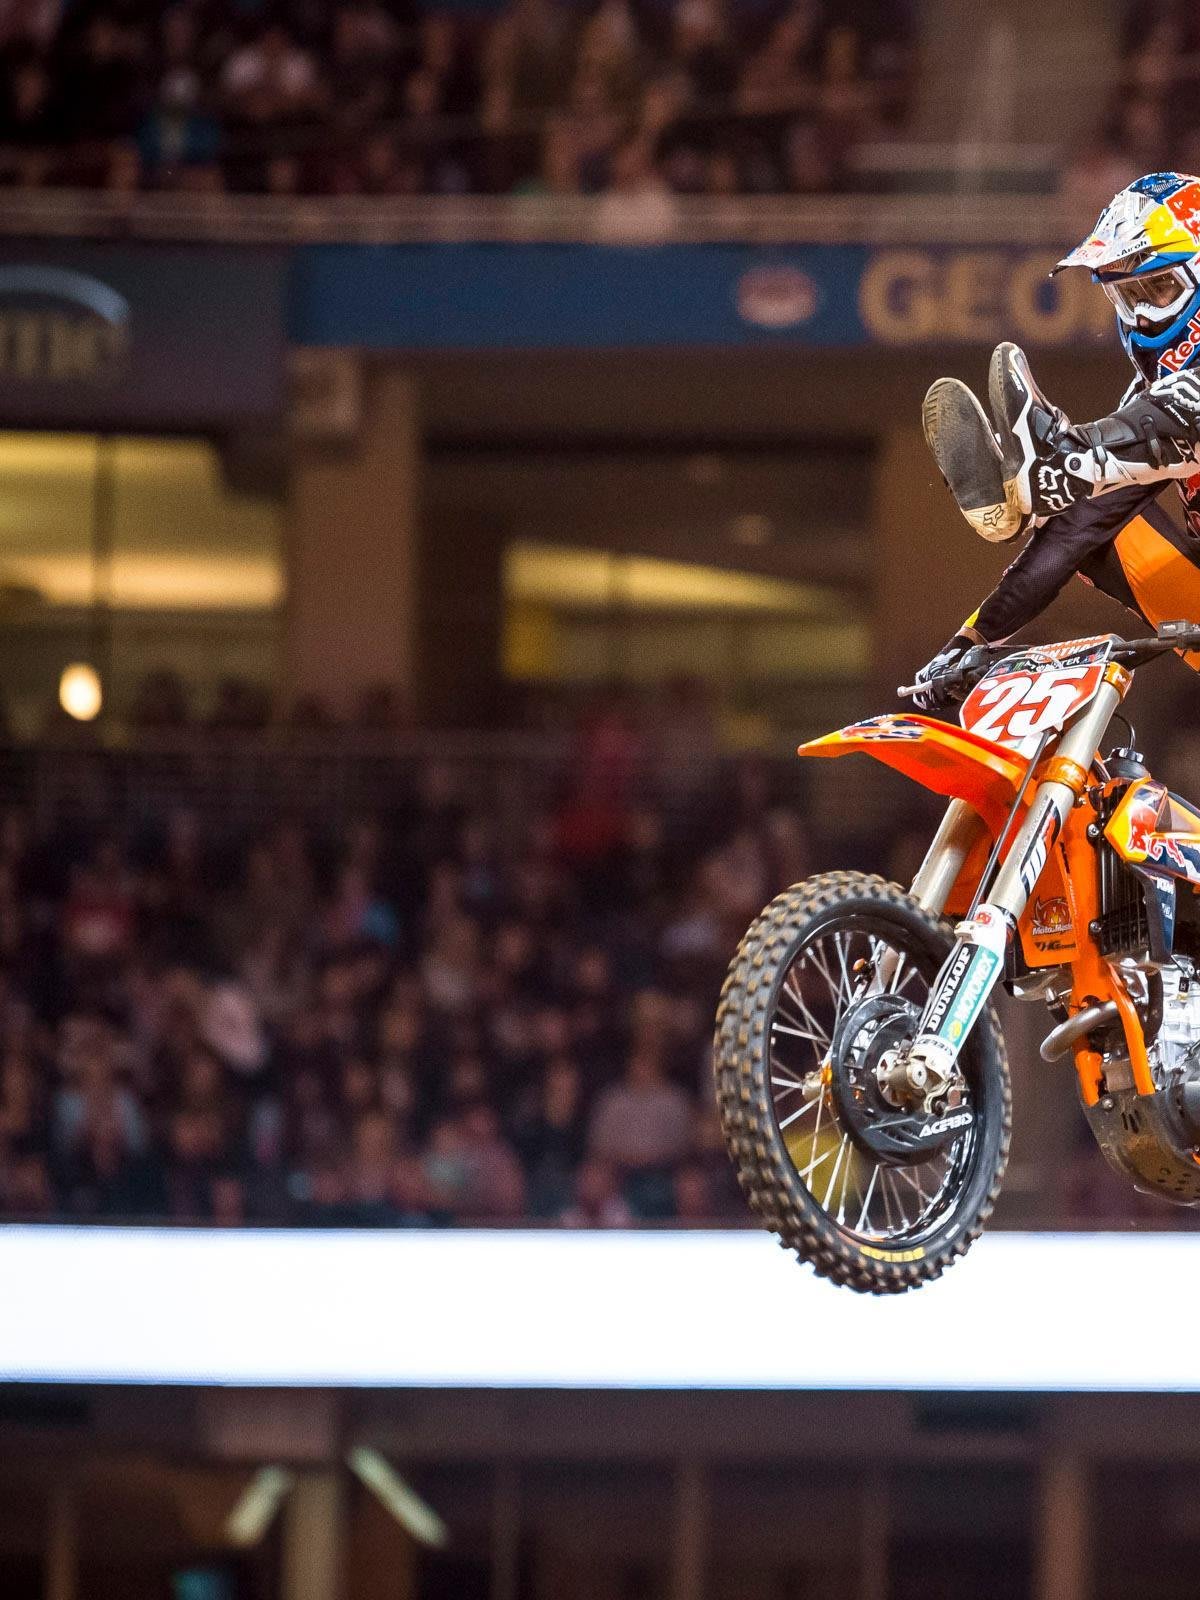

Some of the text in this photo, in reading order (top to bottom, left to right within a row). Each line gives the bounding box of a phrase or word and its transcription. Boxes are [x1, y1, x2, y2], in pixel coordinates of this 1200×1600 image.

[1121, 240, 1147, 256] Airoh
[970, 667, 1090, 743] 25
[927, 947, 970, 1032] DUNLOP
